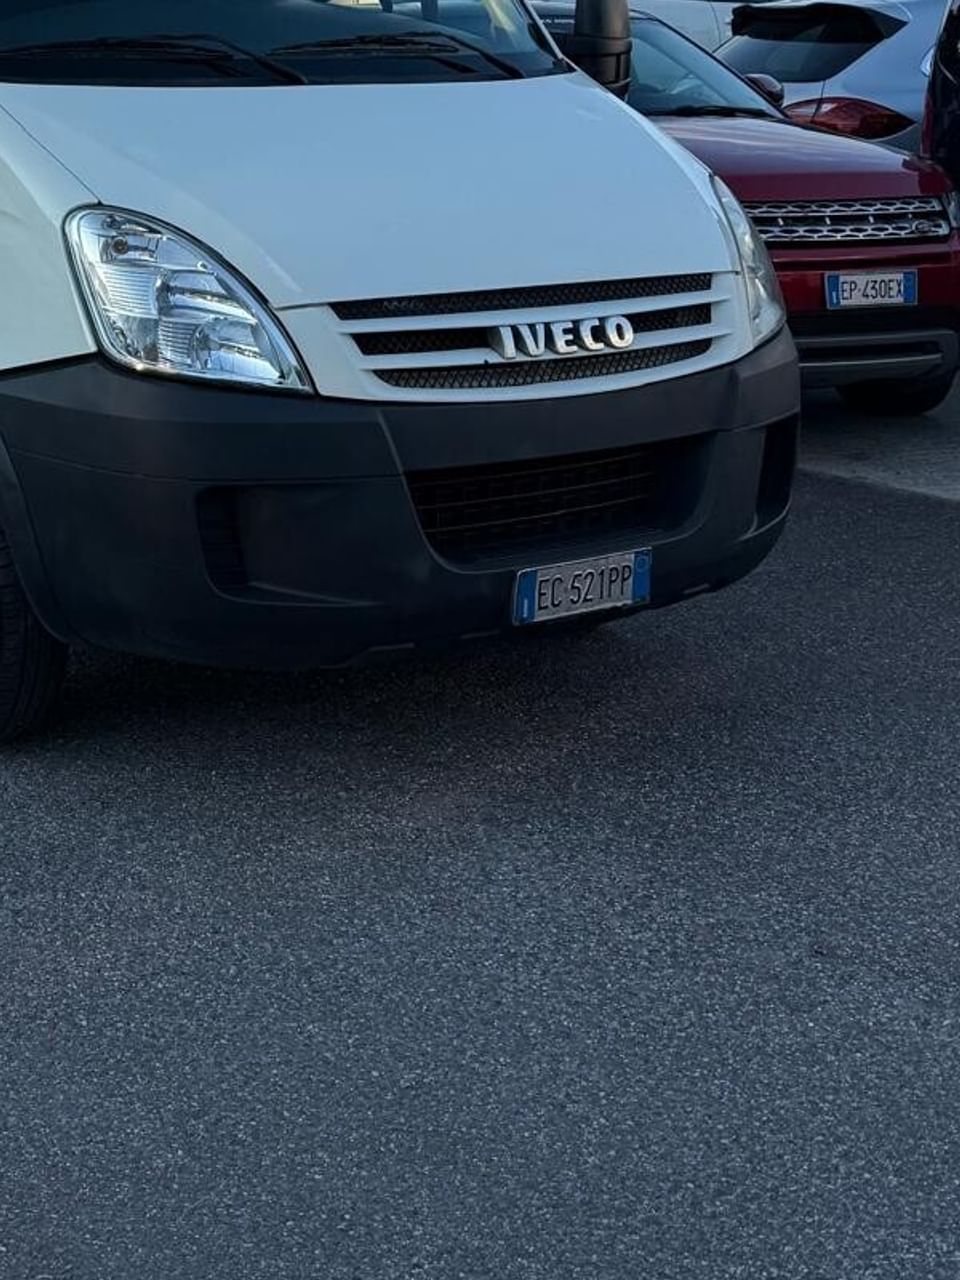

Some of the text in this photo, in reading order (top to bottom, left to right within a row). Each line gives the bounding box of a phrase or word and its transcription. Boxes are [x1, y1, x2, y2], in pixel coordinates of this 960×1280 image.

[862, 278, 903, 300] 430EX
[496, 314, 635, 360] IVECO
[538, 564, 633, 611] EC 521PP
